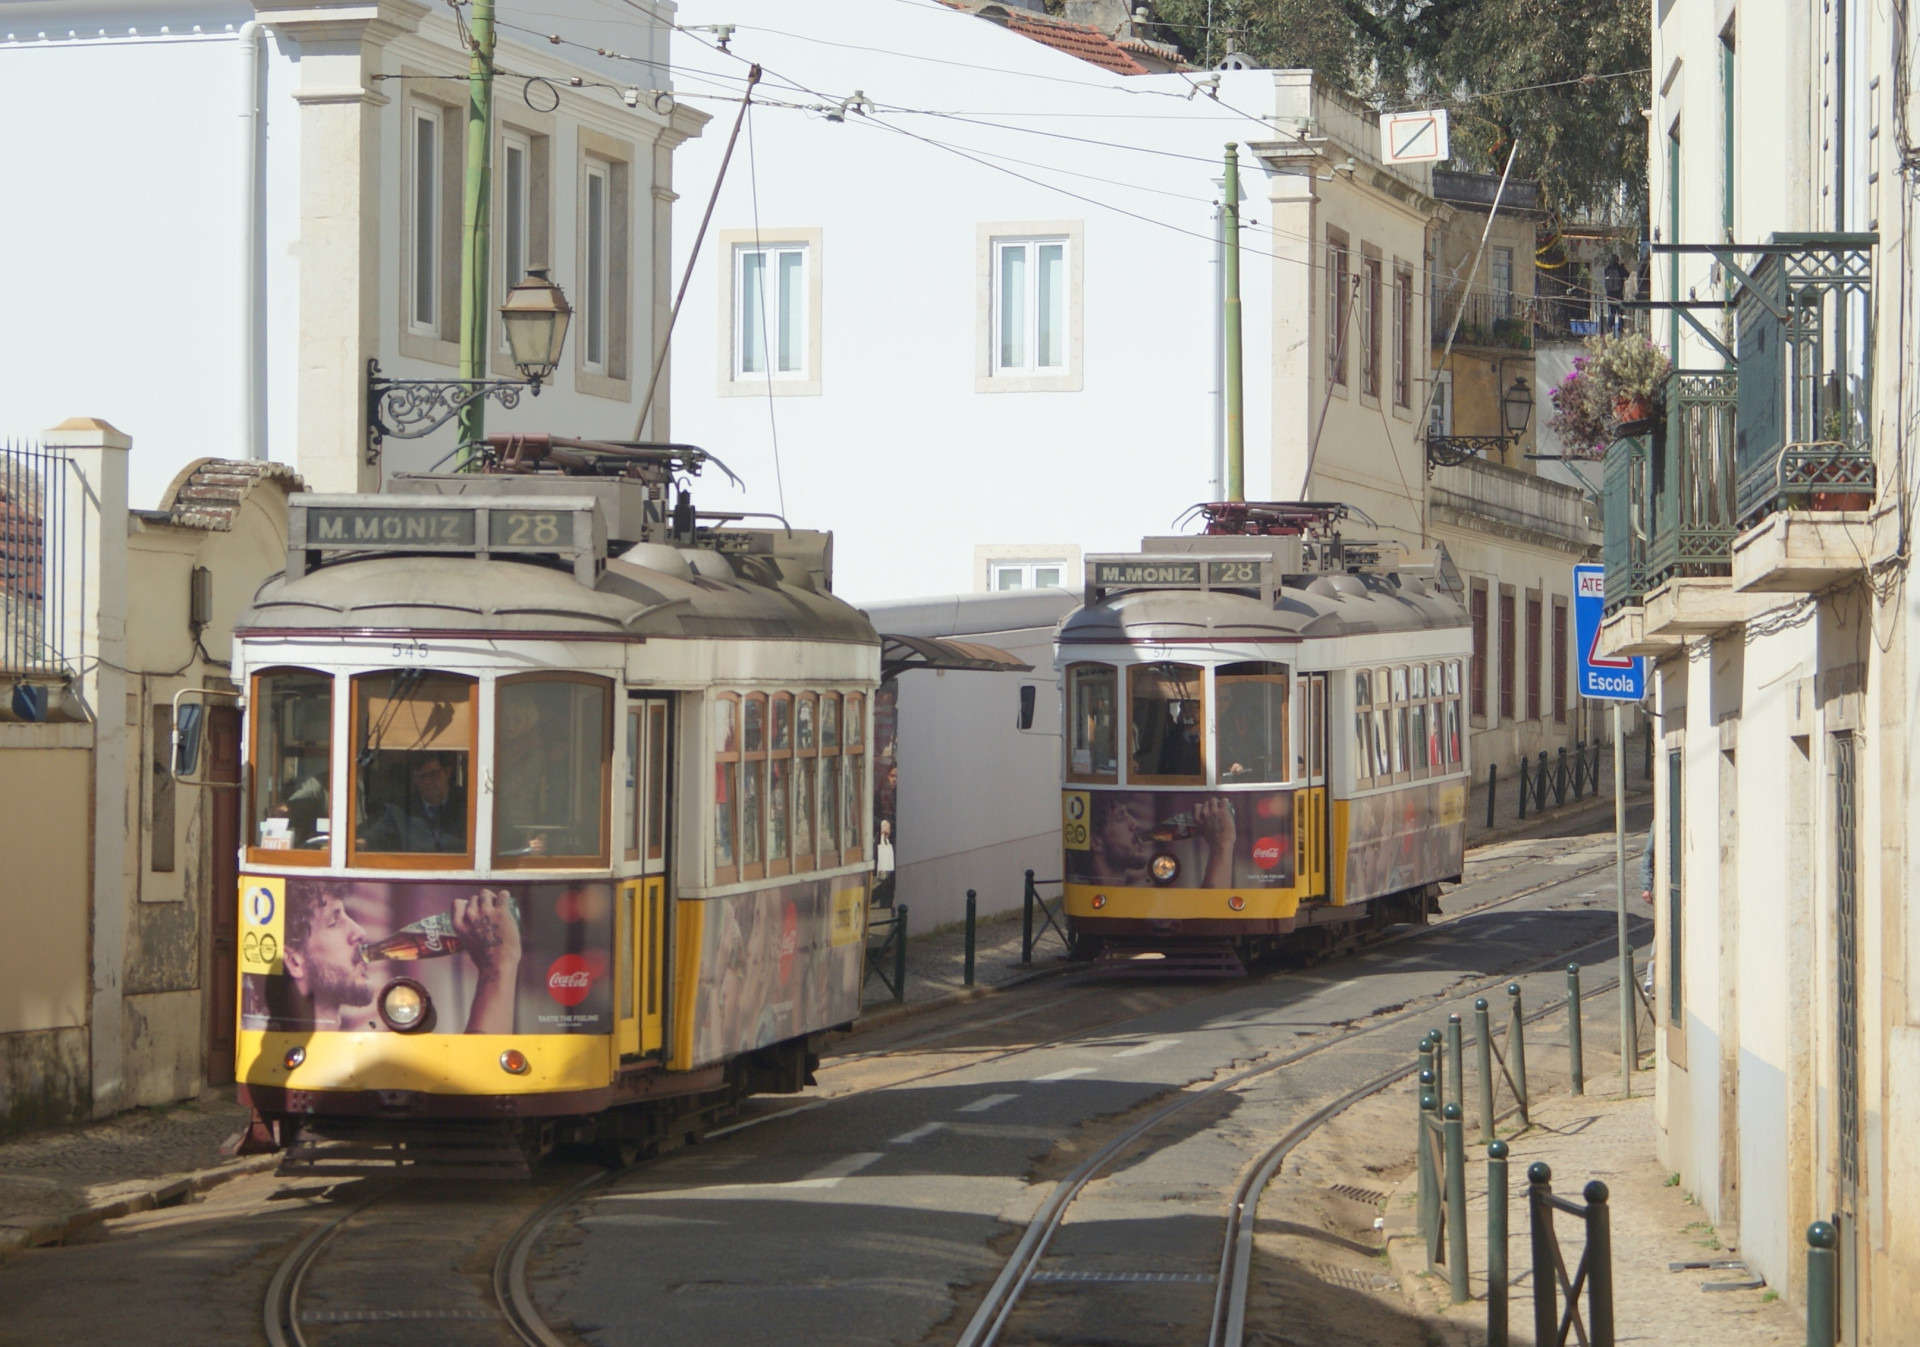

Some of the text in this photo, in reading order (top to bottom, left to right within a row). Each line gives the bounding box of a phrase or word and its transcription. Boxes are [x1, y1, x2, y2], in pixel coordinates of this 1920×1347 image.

[317, 513, 560, 545] M.MONIZ 28
[1101, 561, 1254, 583] M.MONIZ 28
[1580, 577, 1604, 592] ATE
[391, 643, 430, 659] 545
[1587, 671, 1635, 693] Escola
